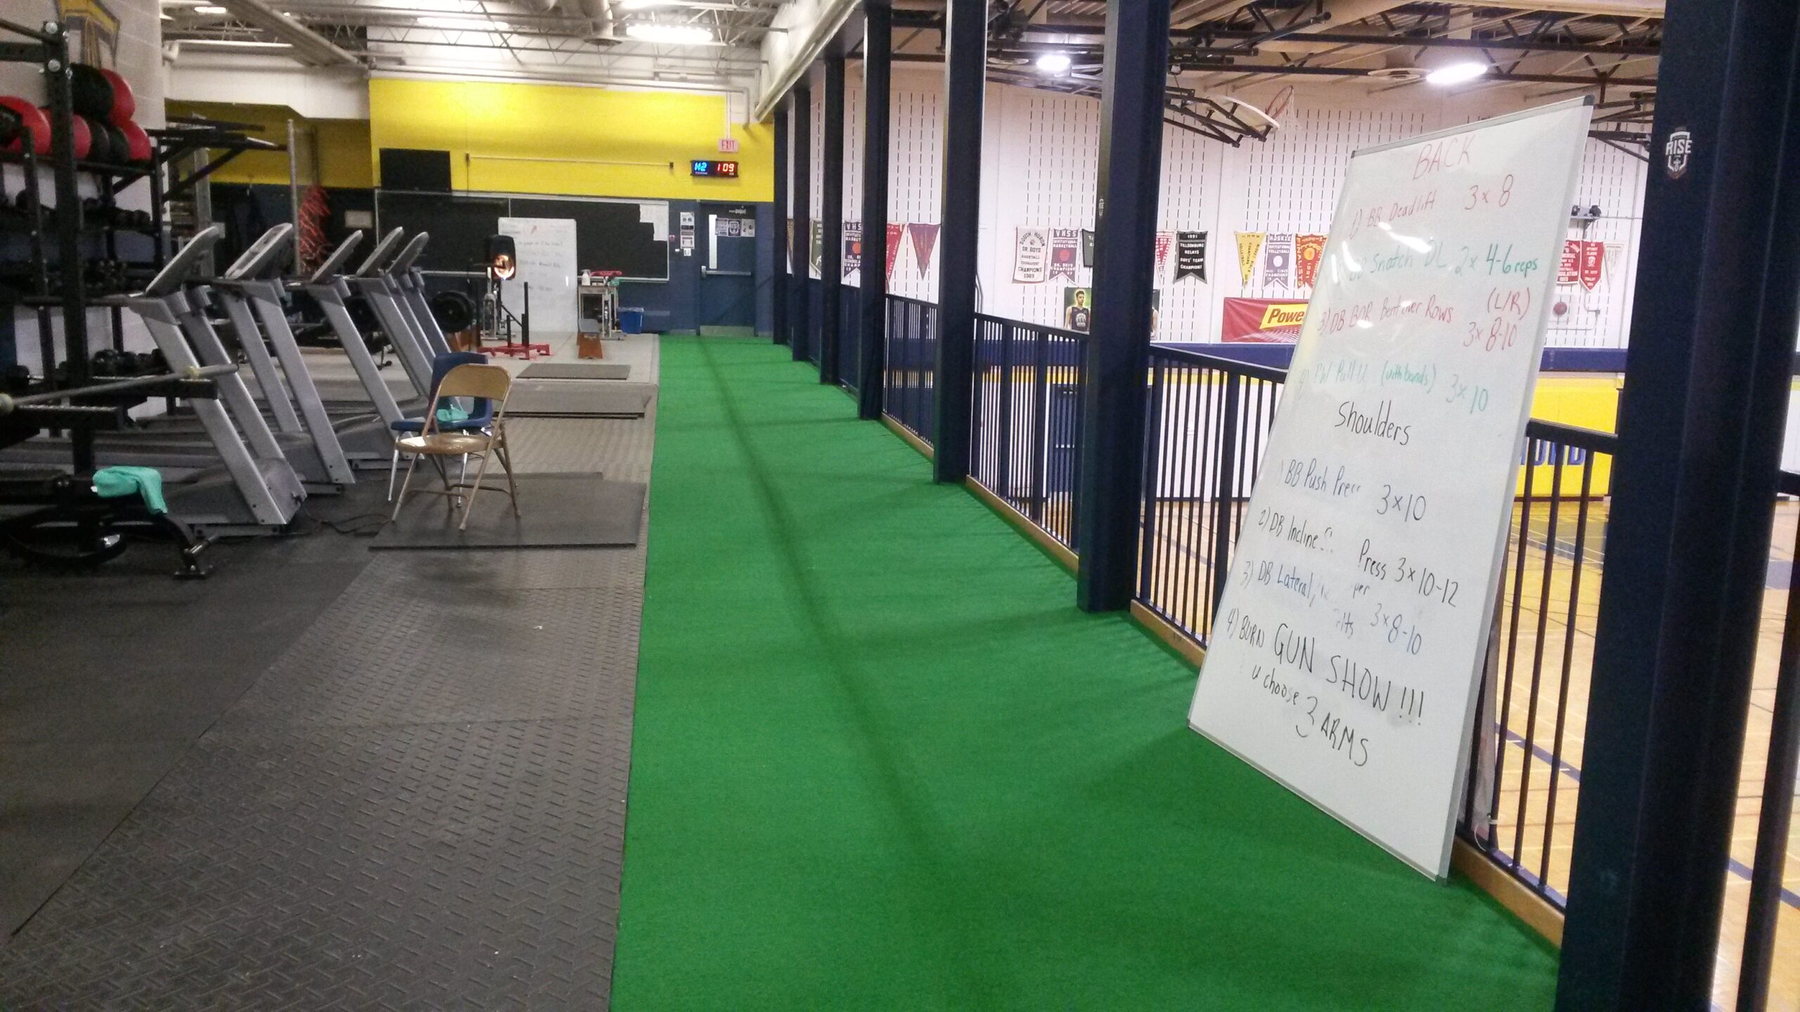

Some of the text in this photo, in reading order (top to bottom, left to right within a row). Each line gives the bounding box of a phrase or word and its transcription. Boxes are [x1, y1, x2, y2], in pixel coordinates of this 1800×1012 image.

[721, 139, 736, 150] EXIT
[1413, 134, 1476, 181] BACK
[1665, 138, 1693, 156] RISE
[1389, 189, 1439, 222] Deadlift
[1486, 243, 1514, 276] 4-6
[1513, 257, 1539, 278] reps
[1486, 286, 1531, 320] (L/R)
[1334, 400, 1413, 446] Shoulders
[1303, 458, 1328, 496] Push
[1287, 515, 1320, 551] Incline
[1357, 537, 1388, 581] Press
[1239, 614, 1266, 649] BURN
[1273, 622, 1316, 674] GUN
[1324, 654, 1393, 713] SHOW
[1263, 667, 1300, 706] choose
[1320, 711, 1369, 768] ARMS
